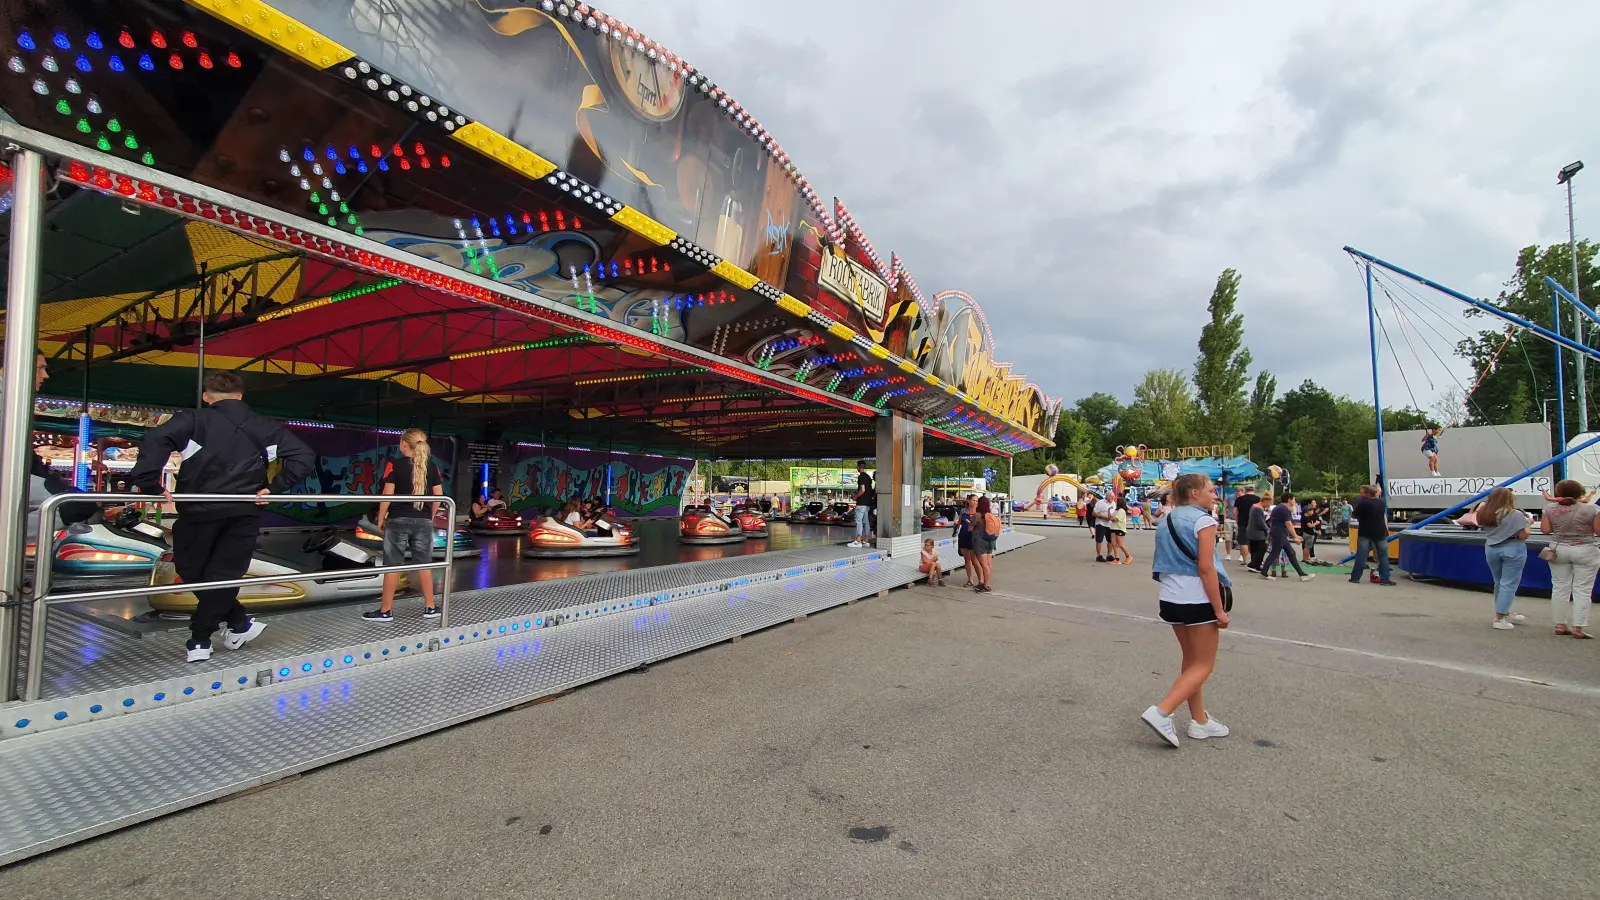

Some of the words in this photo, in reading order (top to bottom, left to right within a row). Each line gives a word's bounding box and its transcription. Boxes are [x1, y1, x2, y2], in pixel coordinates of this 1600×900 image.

[637, 73, 656, 108] bpm
[1389, 480, 1453, 495] Kirchweih
[1458, 477, 1496, 494] 2023
